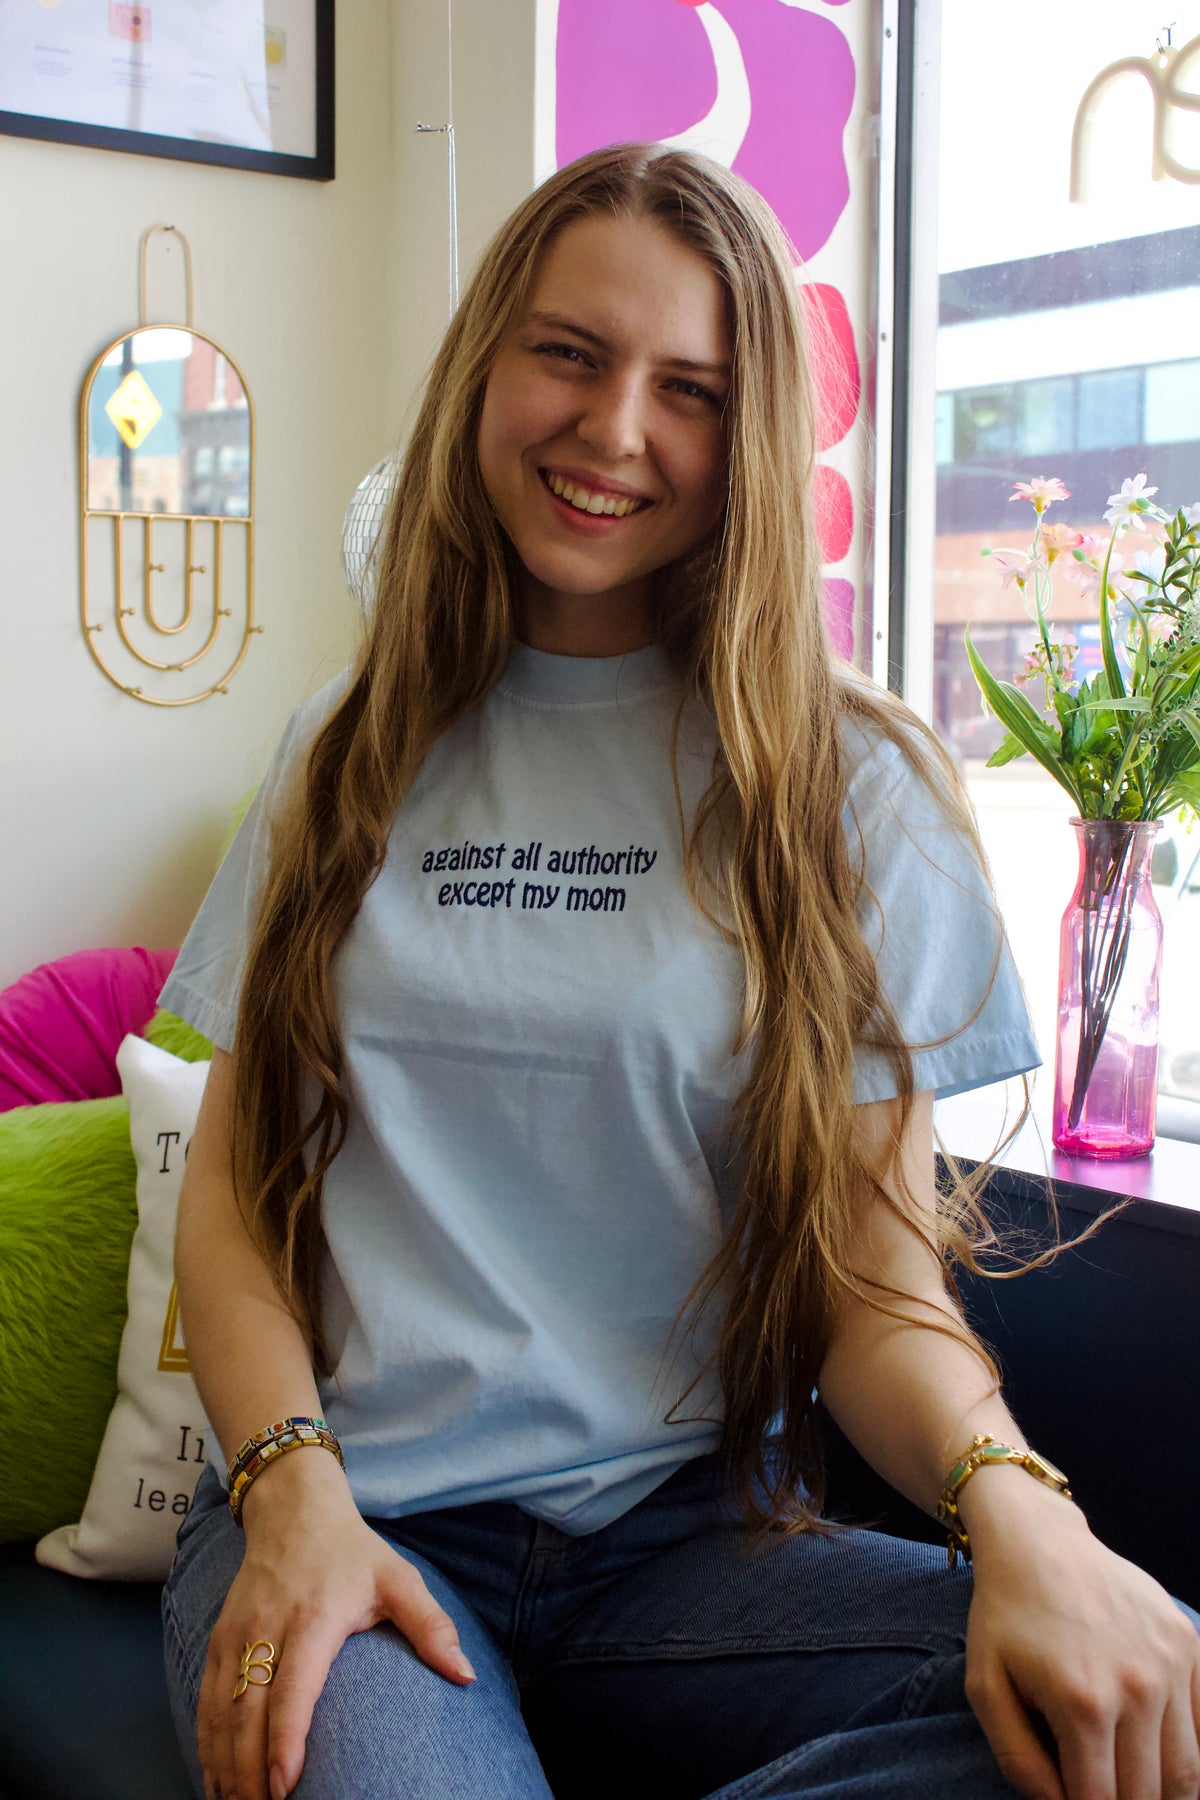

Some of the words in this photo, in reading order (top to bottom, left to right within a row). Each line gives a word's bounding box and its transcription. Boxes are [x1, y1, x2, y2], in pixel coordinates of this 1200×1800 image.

[422, 841, 507, 873] against
[511, 842, 543, 871] all
[547, 845, 657, 875] authority
[438, 878, 516, 908] except
[521, 882, 560, 909] my
[566, 886, 626, 911] mom
[157, 1132, 191, 1173] T
